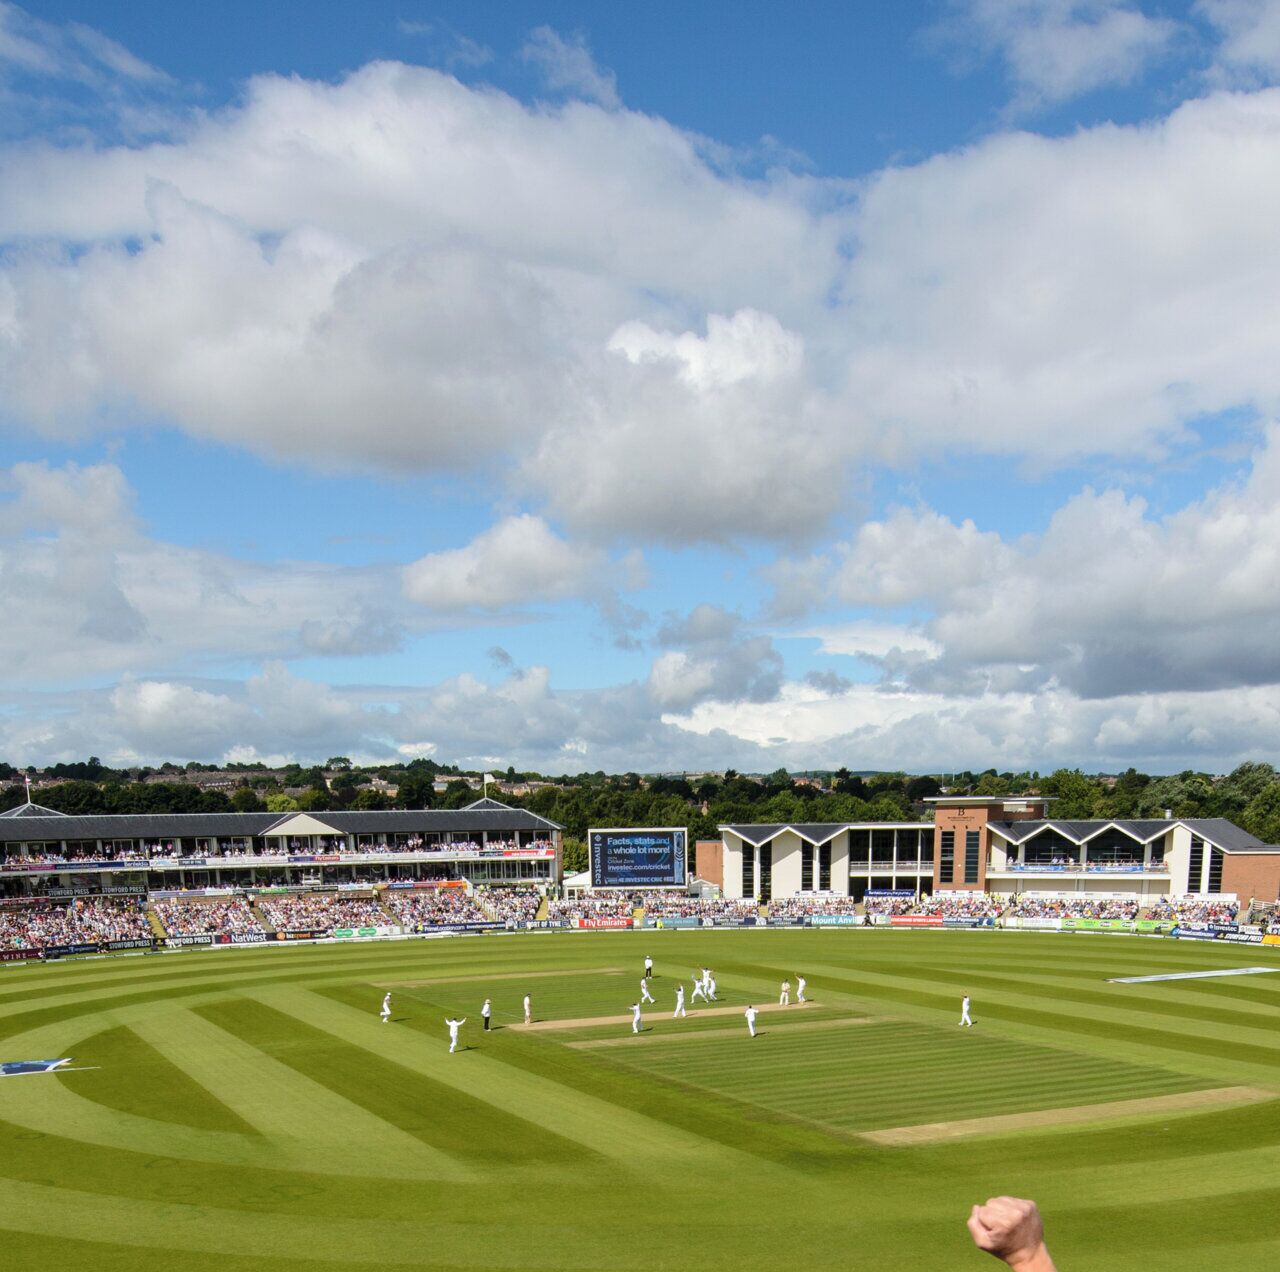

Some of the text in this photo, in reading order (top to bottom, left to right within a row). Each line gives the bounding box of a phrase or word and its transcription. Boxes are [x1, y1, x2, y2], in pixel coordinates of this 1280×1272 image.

[608, 838, 632, 846] Facts,
[594, 843, 602, 885] Investec
[584, 918, 627, 928] Fly Emirates
[812, 916, 837, 924] Mount
[1213, 924, 1237, 932] Investec
[194, 936, 211, 944] PRESS
[231, 934, 266, 943] NatWest
